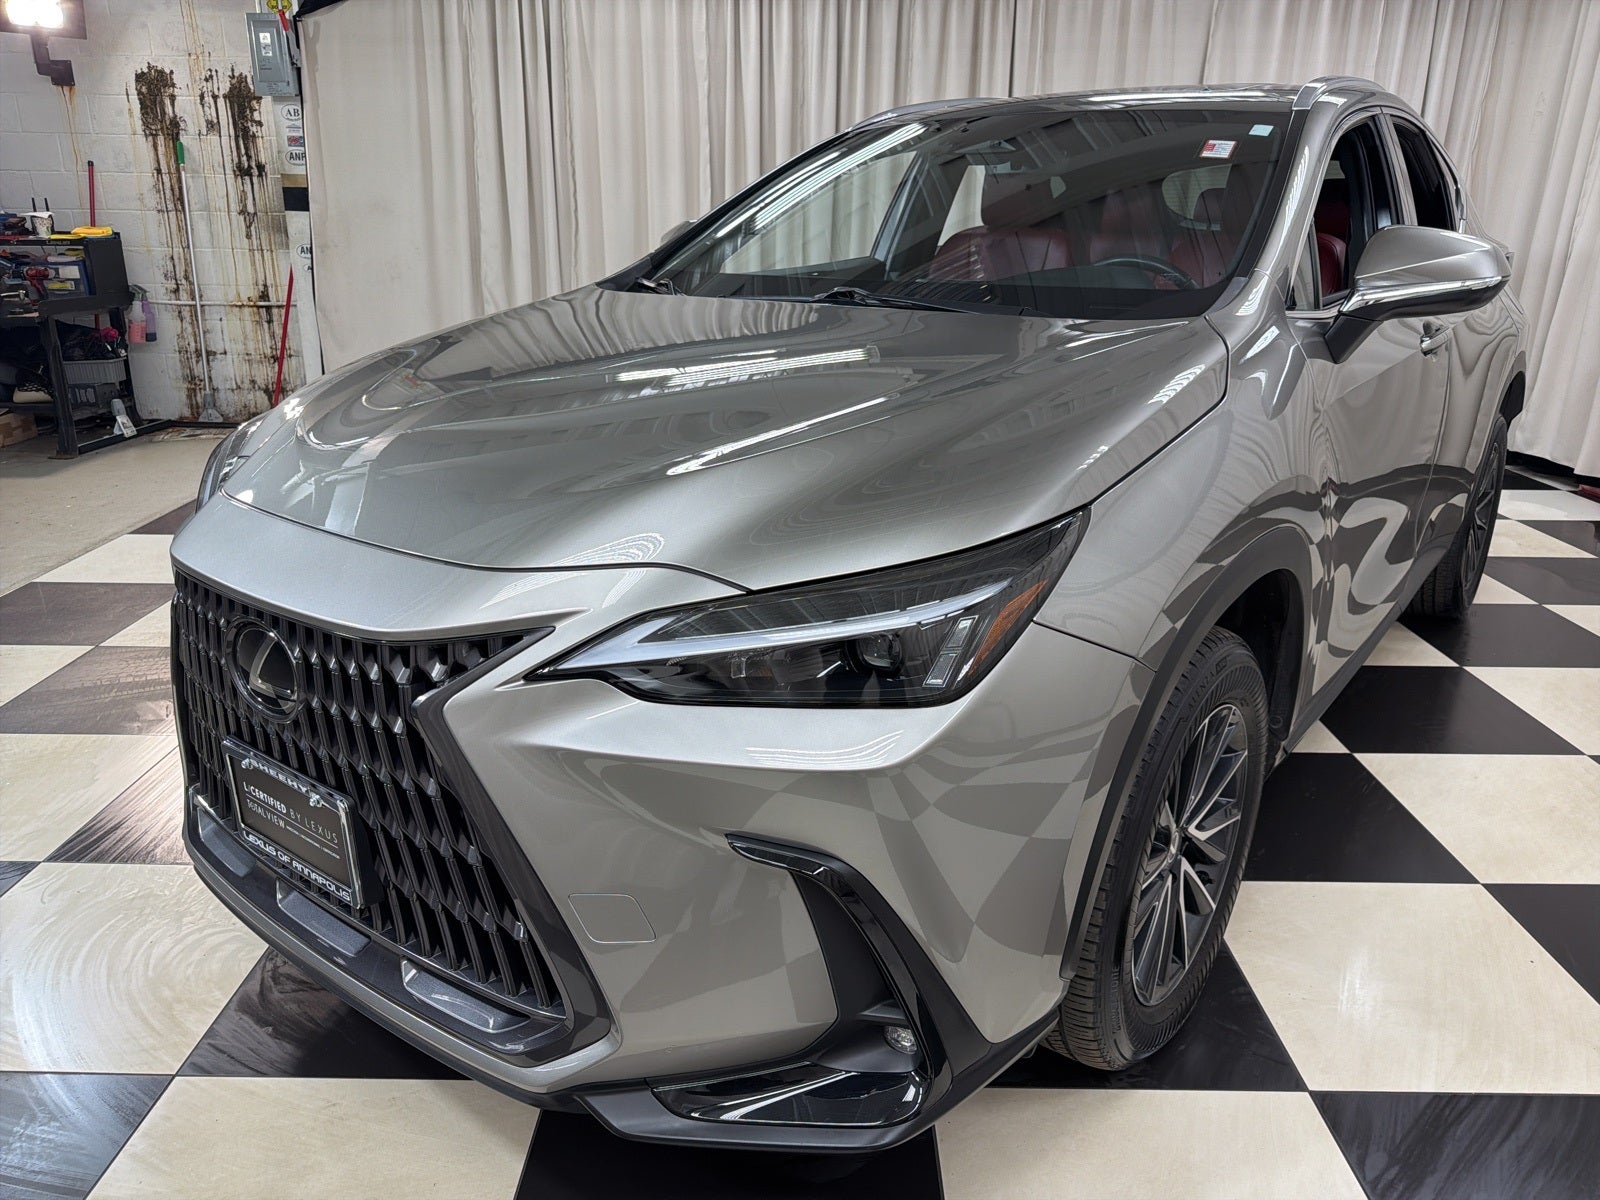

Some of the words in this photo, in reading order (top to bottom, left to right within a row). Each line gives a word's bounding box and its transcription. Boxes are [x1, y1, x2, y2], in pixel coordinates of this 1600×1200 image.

[290, 808, 301, 822] BY
[304, 817, 338, 843] LEXUS
[243, 830, 277, 856] LEXUS
[277, 851, 291, 863] OF
[292, 860, 351, 901] ANNAPOLIS
